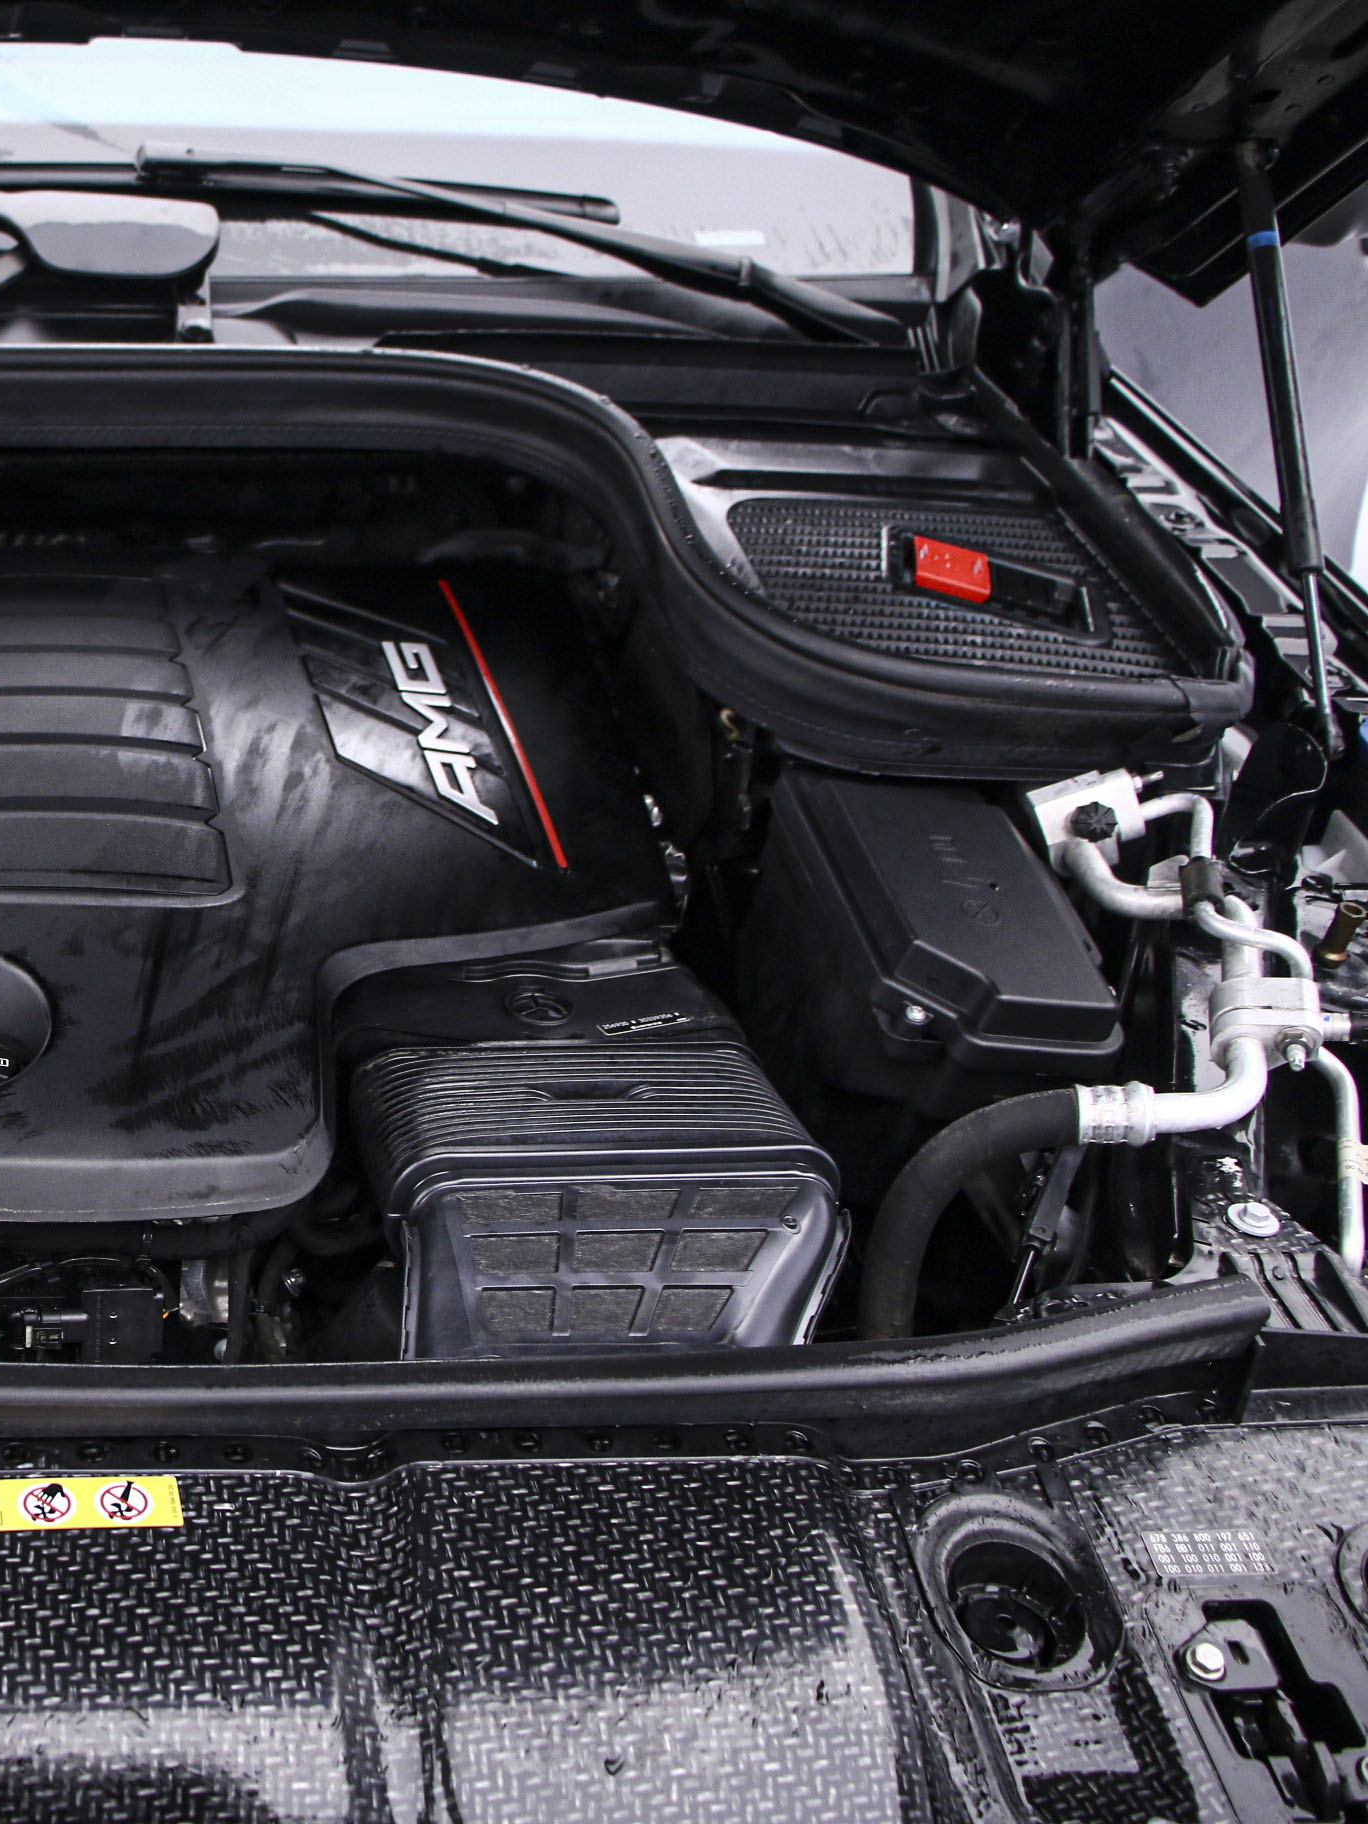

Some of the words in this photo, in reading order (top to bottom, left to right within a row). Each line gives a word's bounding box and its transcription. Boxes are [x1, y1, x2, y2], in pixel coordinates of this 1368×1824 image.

[381, 641, 499, 826] AMG
[1216, 1533, 1232, 1541] 197
[1198, 1543, 1216, 1552] 011
[1220, 1543, 1238, 1552] 001
[1243, 1542, 1260, 1551] 110
[1158, 1555, 1176, 1564] 001
[1180, 1554, 1199, 1563] 100
[1203, 1553, 1221, 1563] 010
[1224, 1553, 1243, 1562] 001
[1248, 1552, 1266, 1562] 100
[1163, 1565, 1181, 1574] 100
[1185, 1565, 1203, 1573] 010
[1207, 1564, 1225, 1573] 011
[1229, 1563, 1248, 1572] 001
